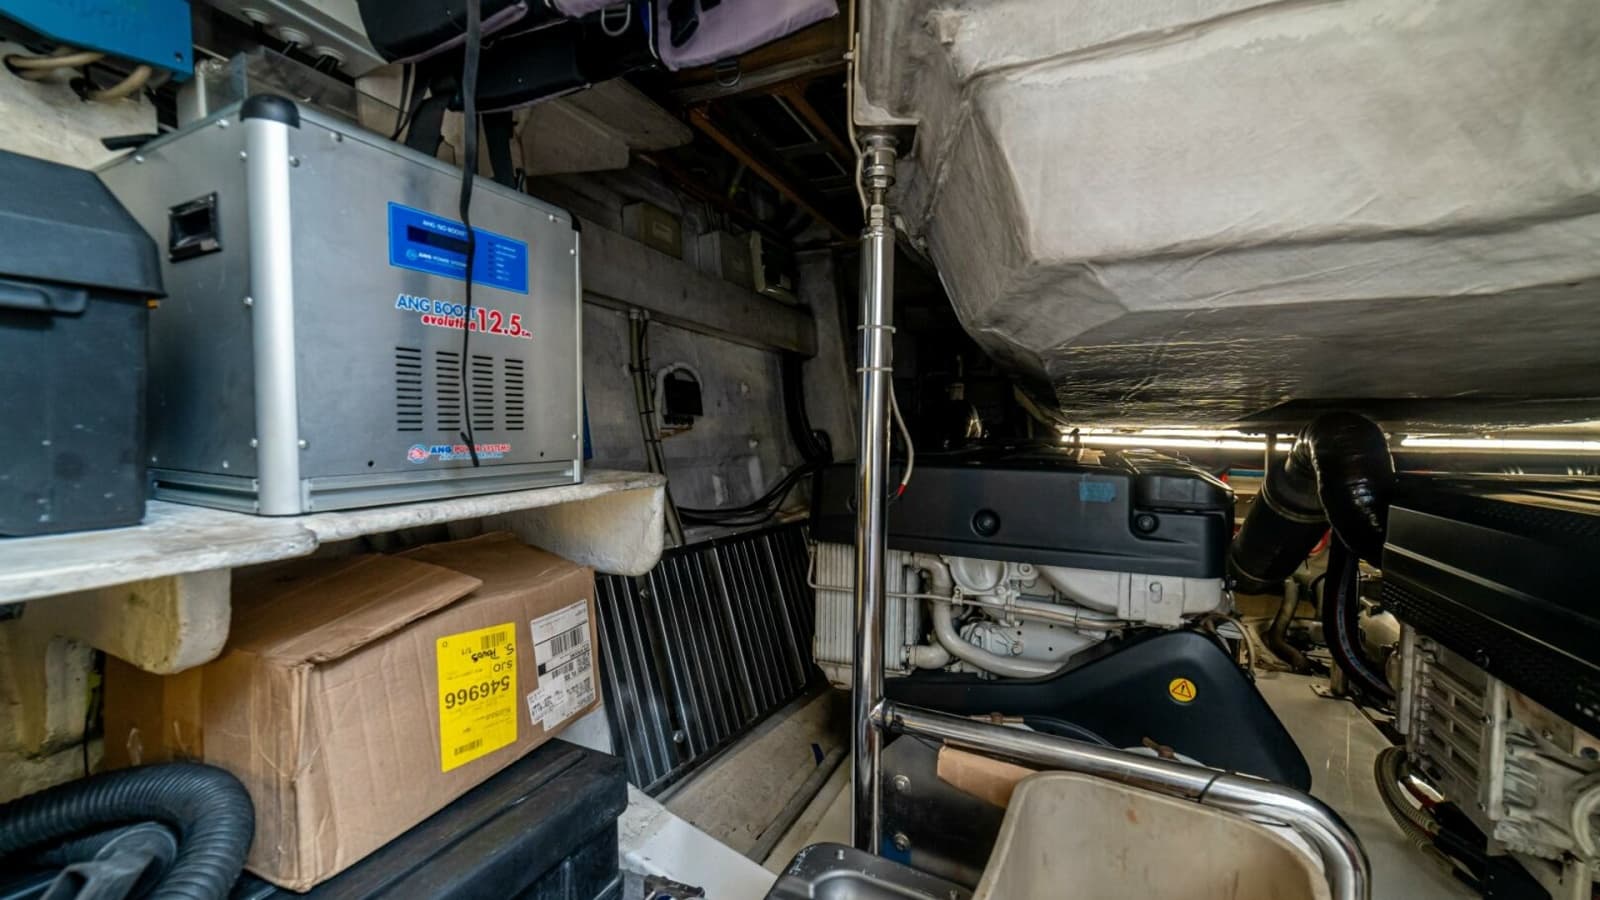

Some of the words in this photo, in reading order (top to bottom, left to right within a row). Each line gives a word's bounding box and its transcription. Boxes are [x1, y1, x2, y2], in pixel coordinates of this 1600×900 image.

[397, 295, 430, 312] ANG
[434, 301, 476, 319] BOOT
[478, 308, 521, 336] 12.5
[431, 446, 452, 454] ANG
[444, 675, 510, 709] 546966
